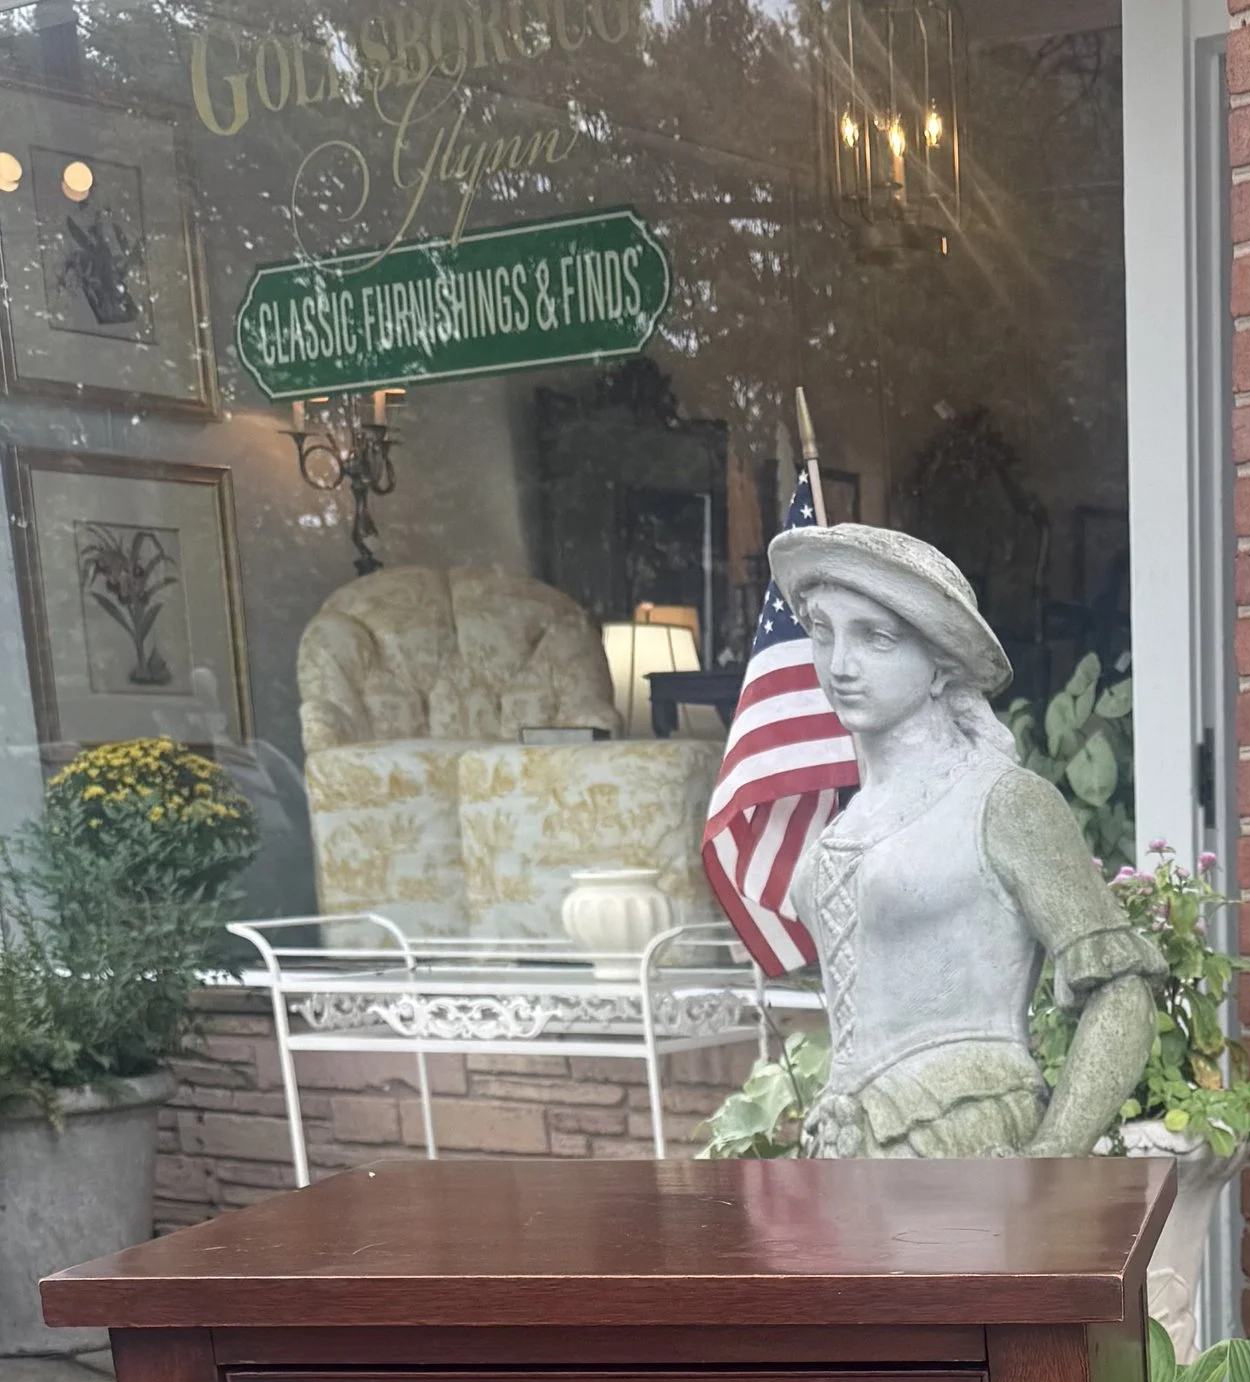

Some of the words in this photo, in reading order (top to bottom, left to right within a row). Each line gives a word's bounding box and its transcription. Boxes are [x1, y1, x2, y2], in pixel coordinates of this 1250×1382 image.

[191, 0, 664, 135] GOLSBOROUG
[292, 50, 580, 274] Glynn
[258, 290, 358, 366] CLASSIC
[362, 265, 530, 352] FURNISHINGS
[535, 262, 559, 331] &
[561, 246, 643, 326] FINDS
